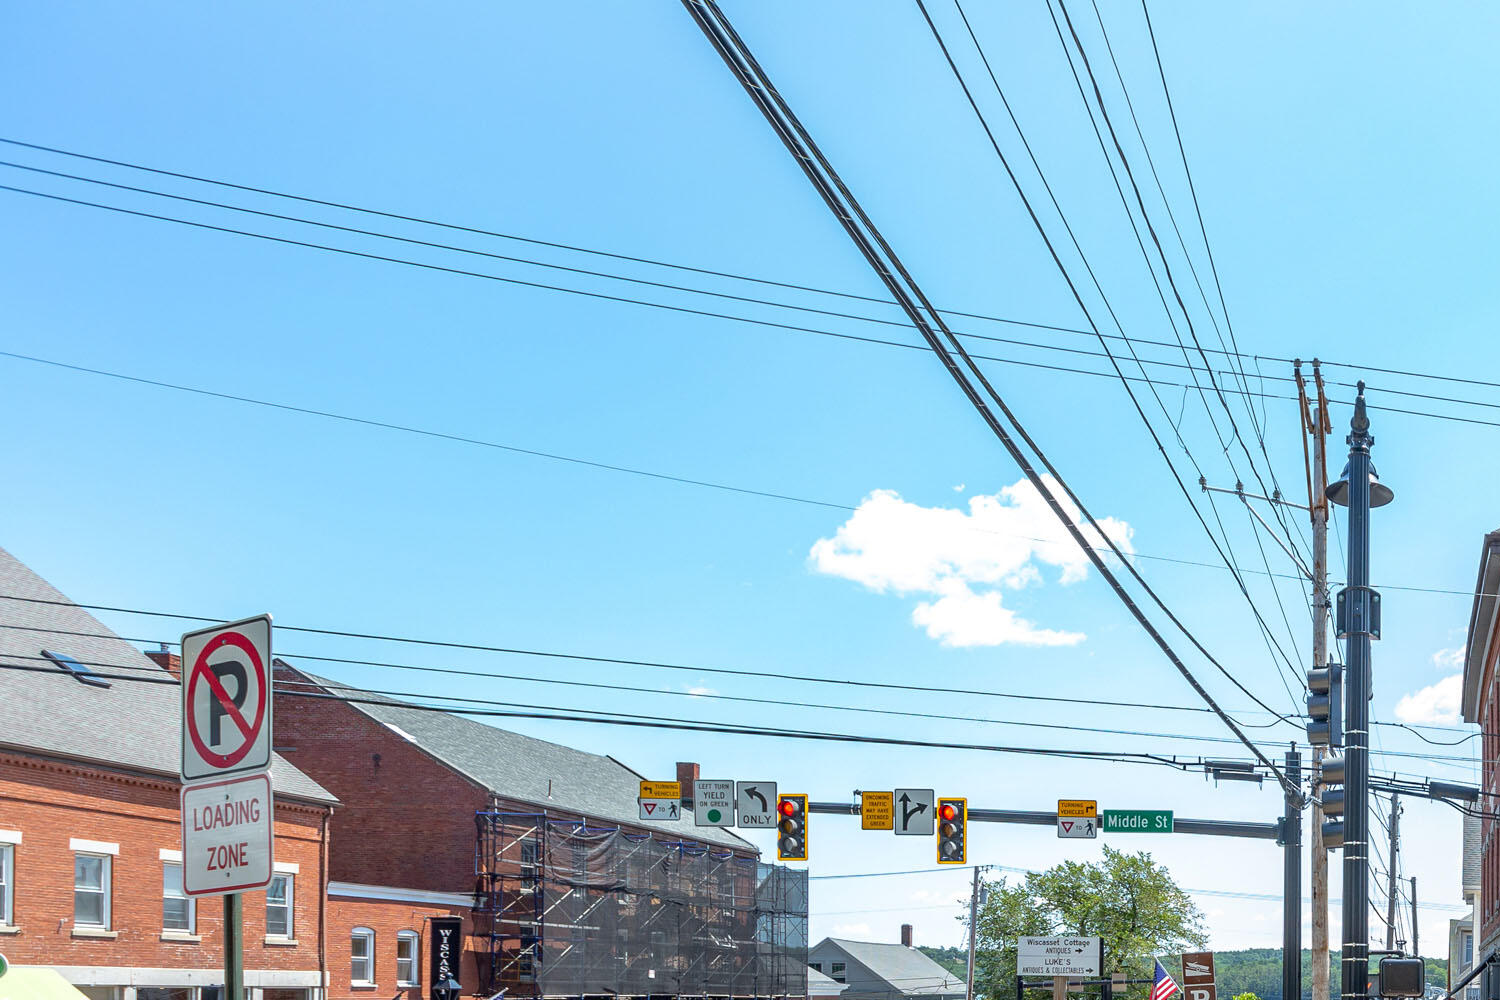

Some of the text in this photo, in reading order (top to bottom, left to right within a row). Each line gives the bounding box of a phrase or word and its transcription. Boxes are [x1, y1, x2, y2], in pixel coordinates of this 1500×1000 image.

[703, 791, 725, 799] YIELD
[193, 798, 260, 832] LOADING
[743, 815, 771, 824] ONLY
[1108, 815, 1168, 828] Middle St
[207, 842, 249, 871] ZONE
[1027, 938, 1090, 948] Wiscasset Cottage
[440, 929, 452, 982] WISCASS
[1044, 958, 1071, 966] LUKE'S
[1052, 966, 1085, 974] COLLECTABLES
